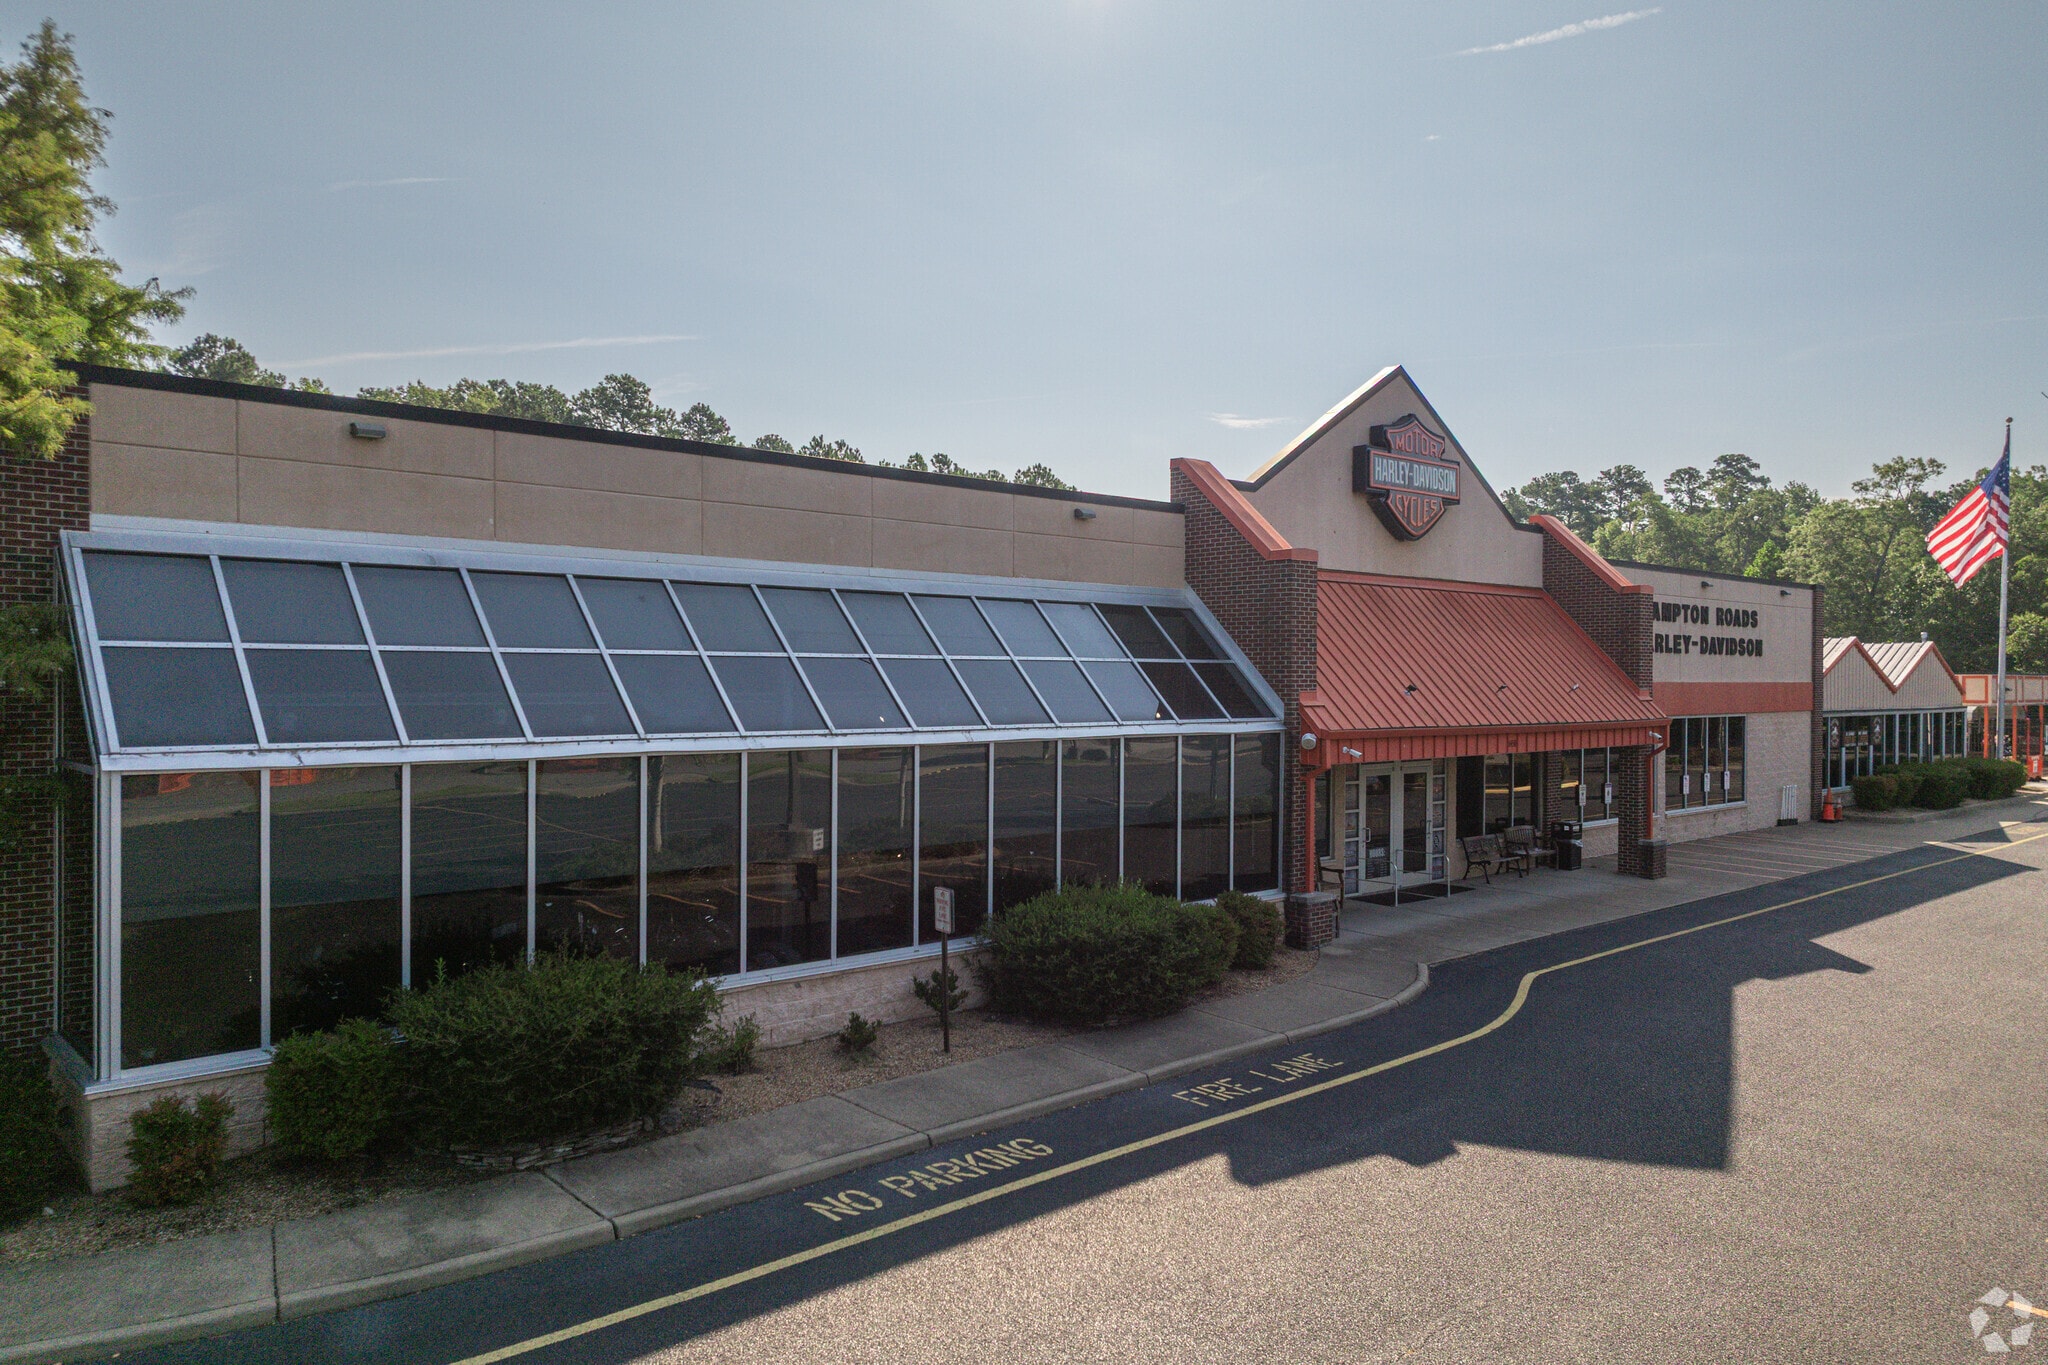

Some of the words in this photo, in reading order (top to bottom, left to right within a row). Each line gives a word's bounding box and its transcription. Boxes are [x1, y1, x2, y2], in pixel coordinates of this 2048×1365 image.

[1396, 429, 1438, 457] MOTOR
[1375, 457, 1457, 493] HARLEY-DAVIDSON
[1396, 494, 1437, 527] CYCLES
[1653, 601, 1710, 625] AMPTON
[1716, 607, 1758, 628] ROADS
[1654, 633, 1763, 657] RLEY-DAVIDSON
[1171, 1077, 1263, 1107] FIRE
[1249, 1052, 1345, 1083] LANE
[803, 1189, 883, 1222] NO
[878, 1138, 1054, 1199] PARKING
